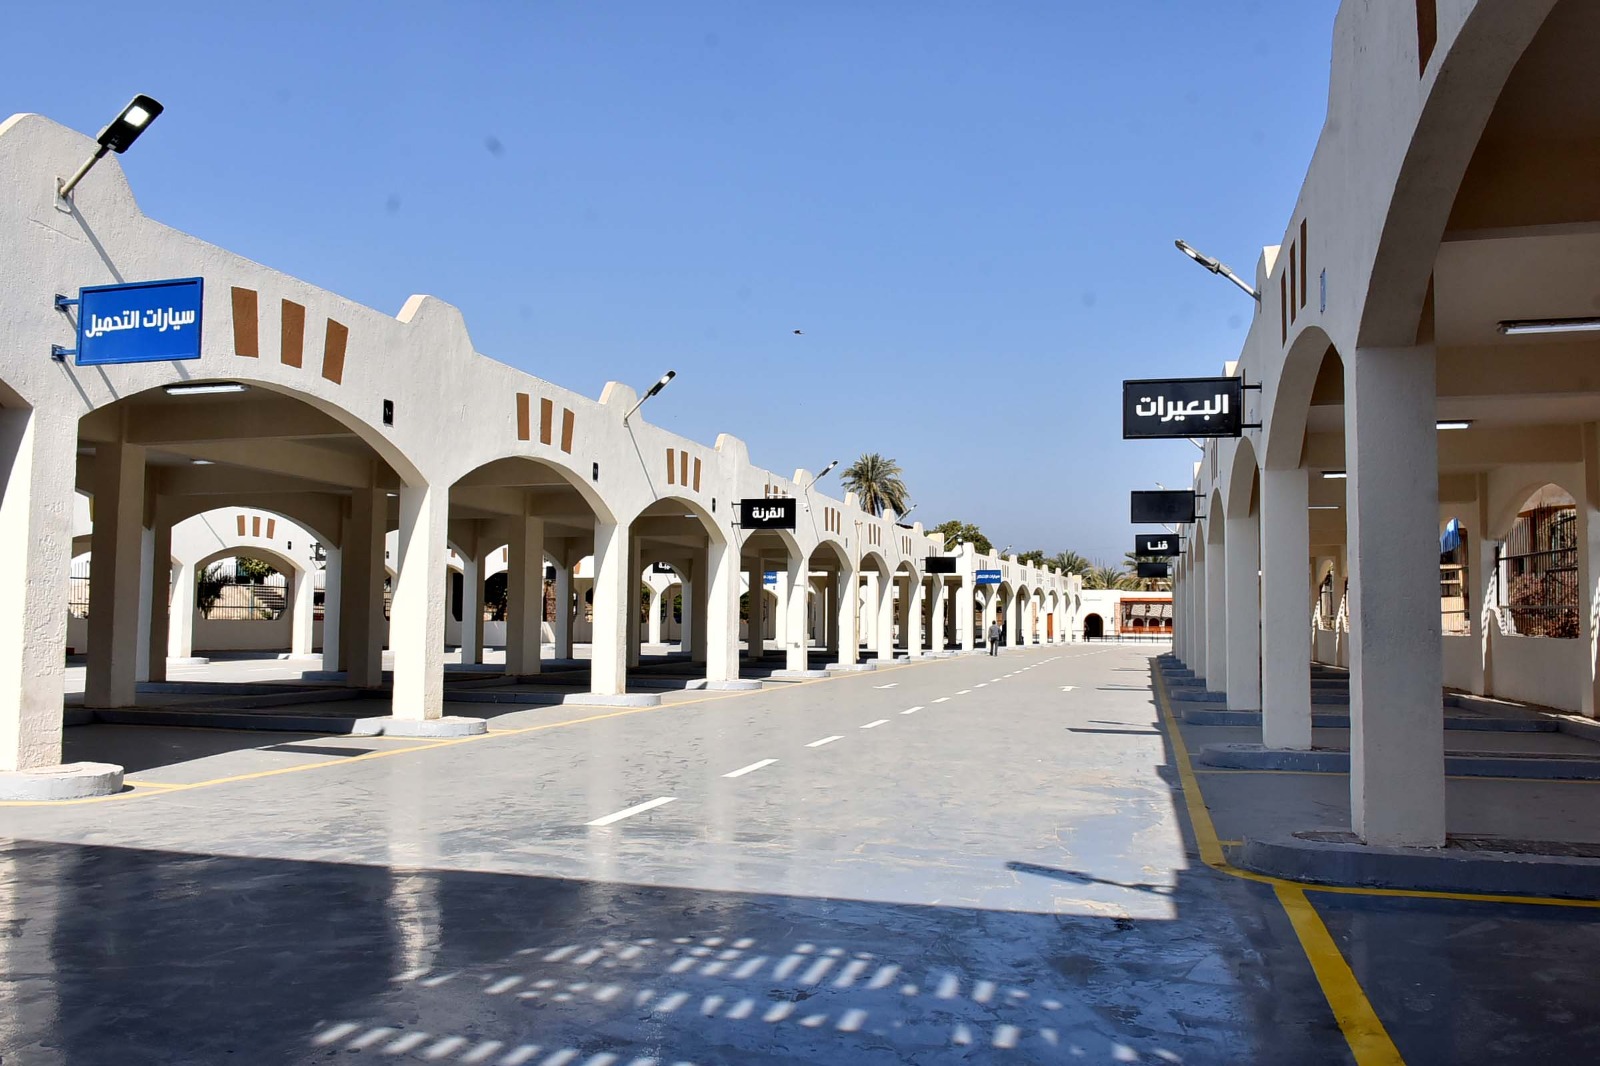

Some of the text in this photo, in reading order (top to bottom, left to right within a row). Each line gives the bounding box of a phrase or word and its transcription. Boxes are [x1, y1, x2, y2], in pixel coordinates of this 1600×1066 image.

[85, 308, 196, 338] سيارات التحميل
[1135, 393, 1229, 422] البعيرات
[752, 506, 785, 522] القرنة
[1147, 540, 1169, 551] قنا
